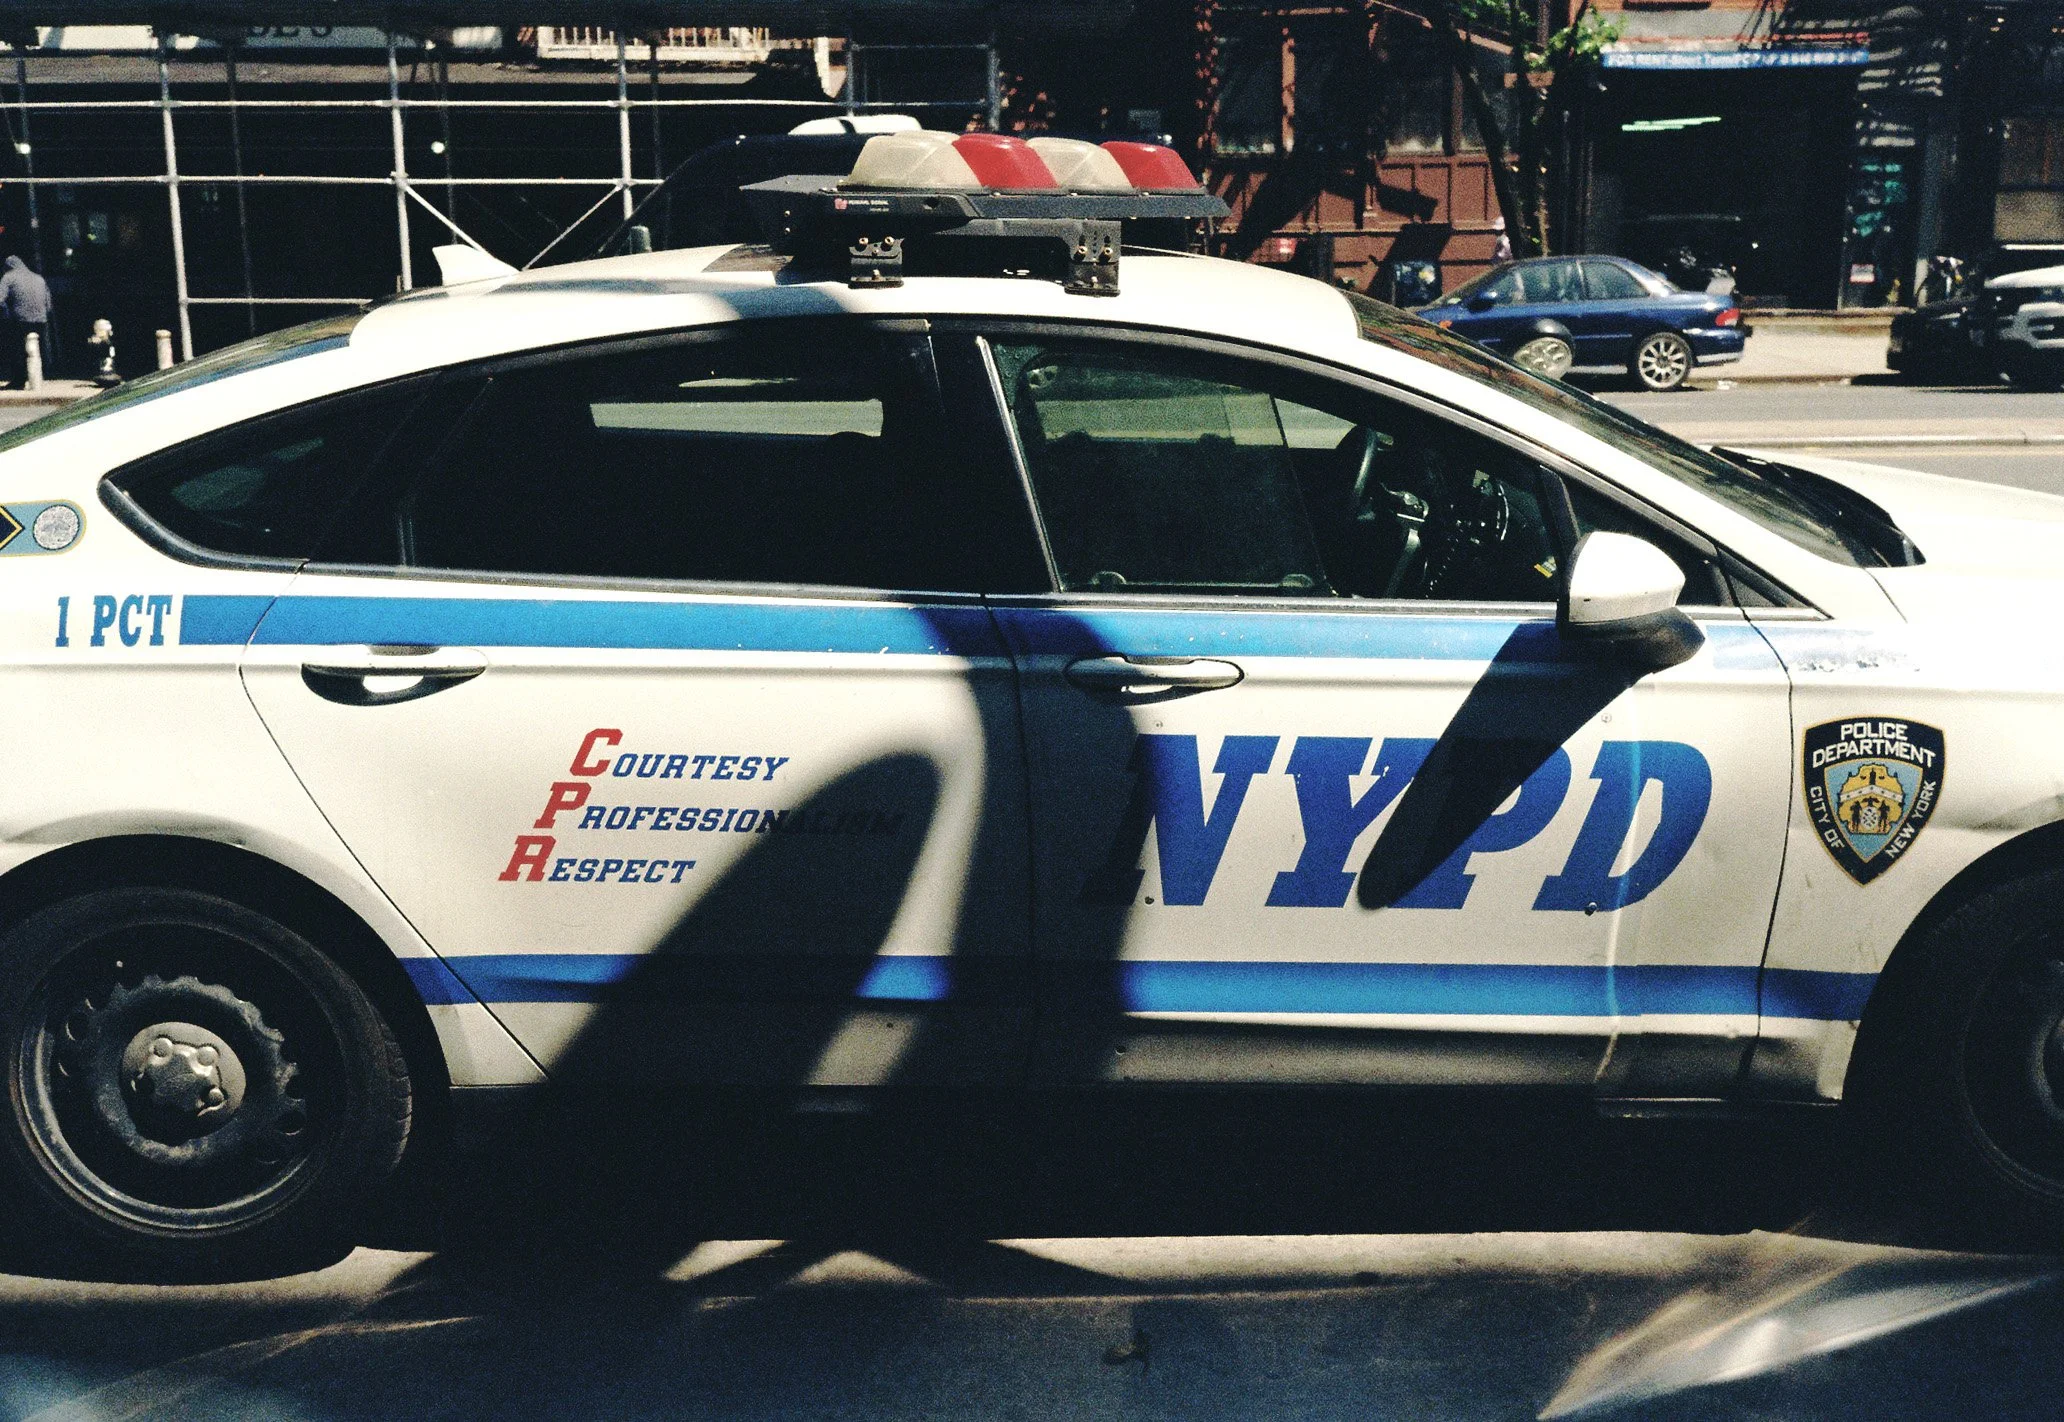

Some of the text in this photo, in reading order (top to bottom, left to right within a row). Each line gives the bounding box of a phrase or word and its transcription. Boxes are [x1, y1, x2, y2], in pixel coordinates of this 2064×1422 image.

[55, 594, 173, 647] 1 PCT
[569, 728, 789, 781] COURTESY
[1812, 739, 1937, 769] DEPARTMENT
[1840, 722, 1909, 741] POLICE
[1076, 735, 1713, 912] NYPD
[1809, 785, 1845, 849] CITY OF
[1885, 780, 1937, 859] NEW YORK
[498, 835, 697, 884] RESPECT
